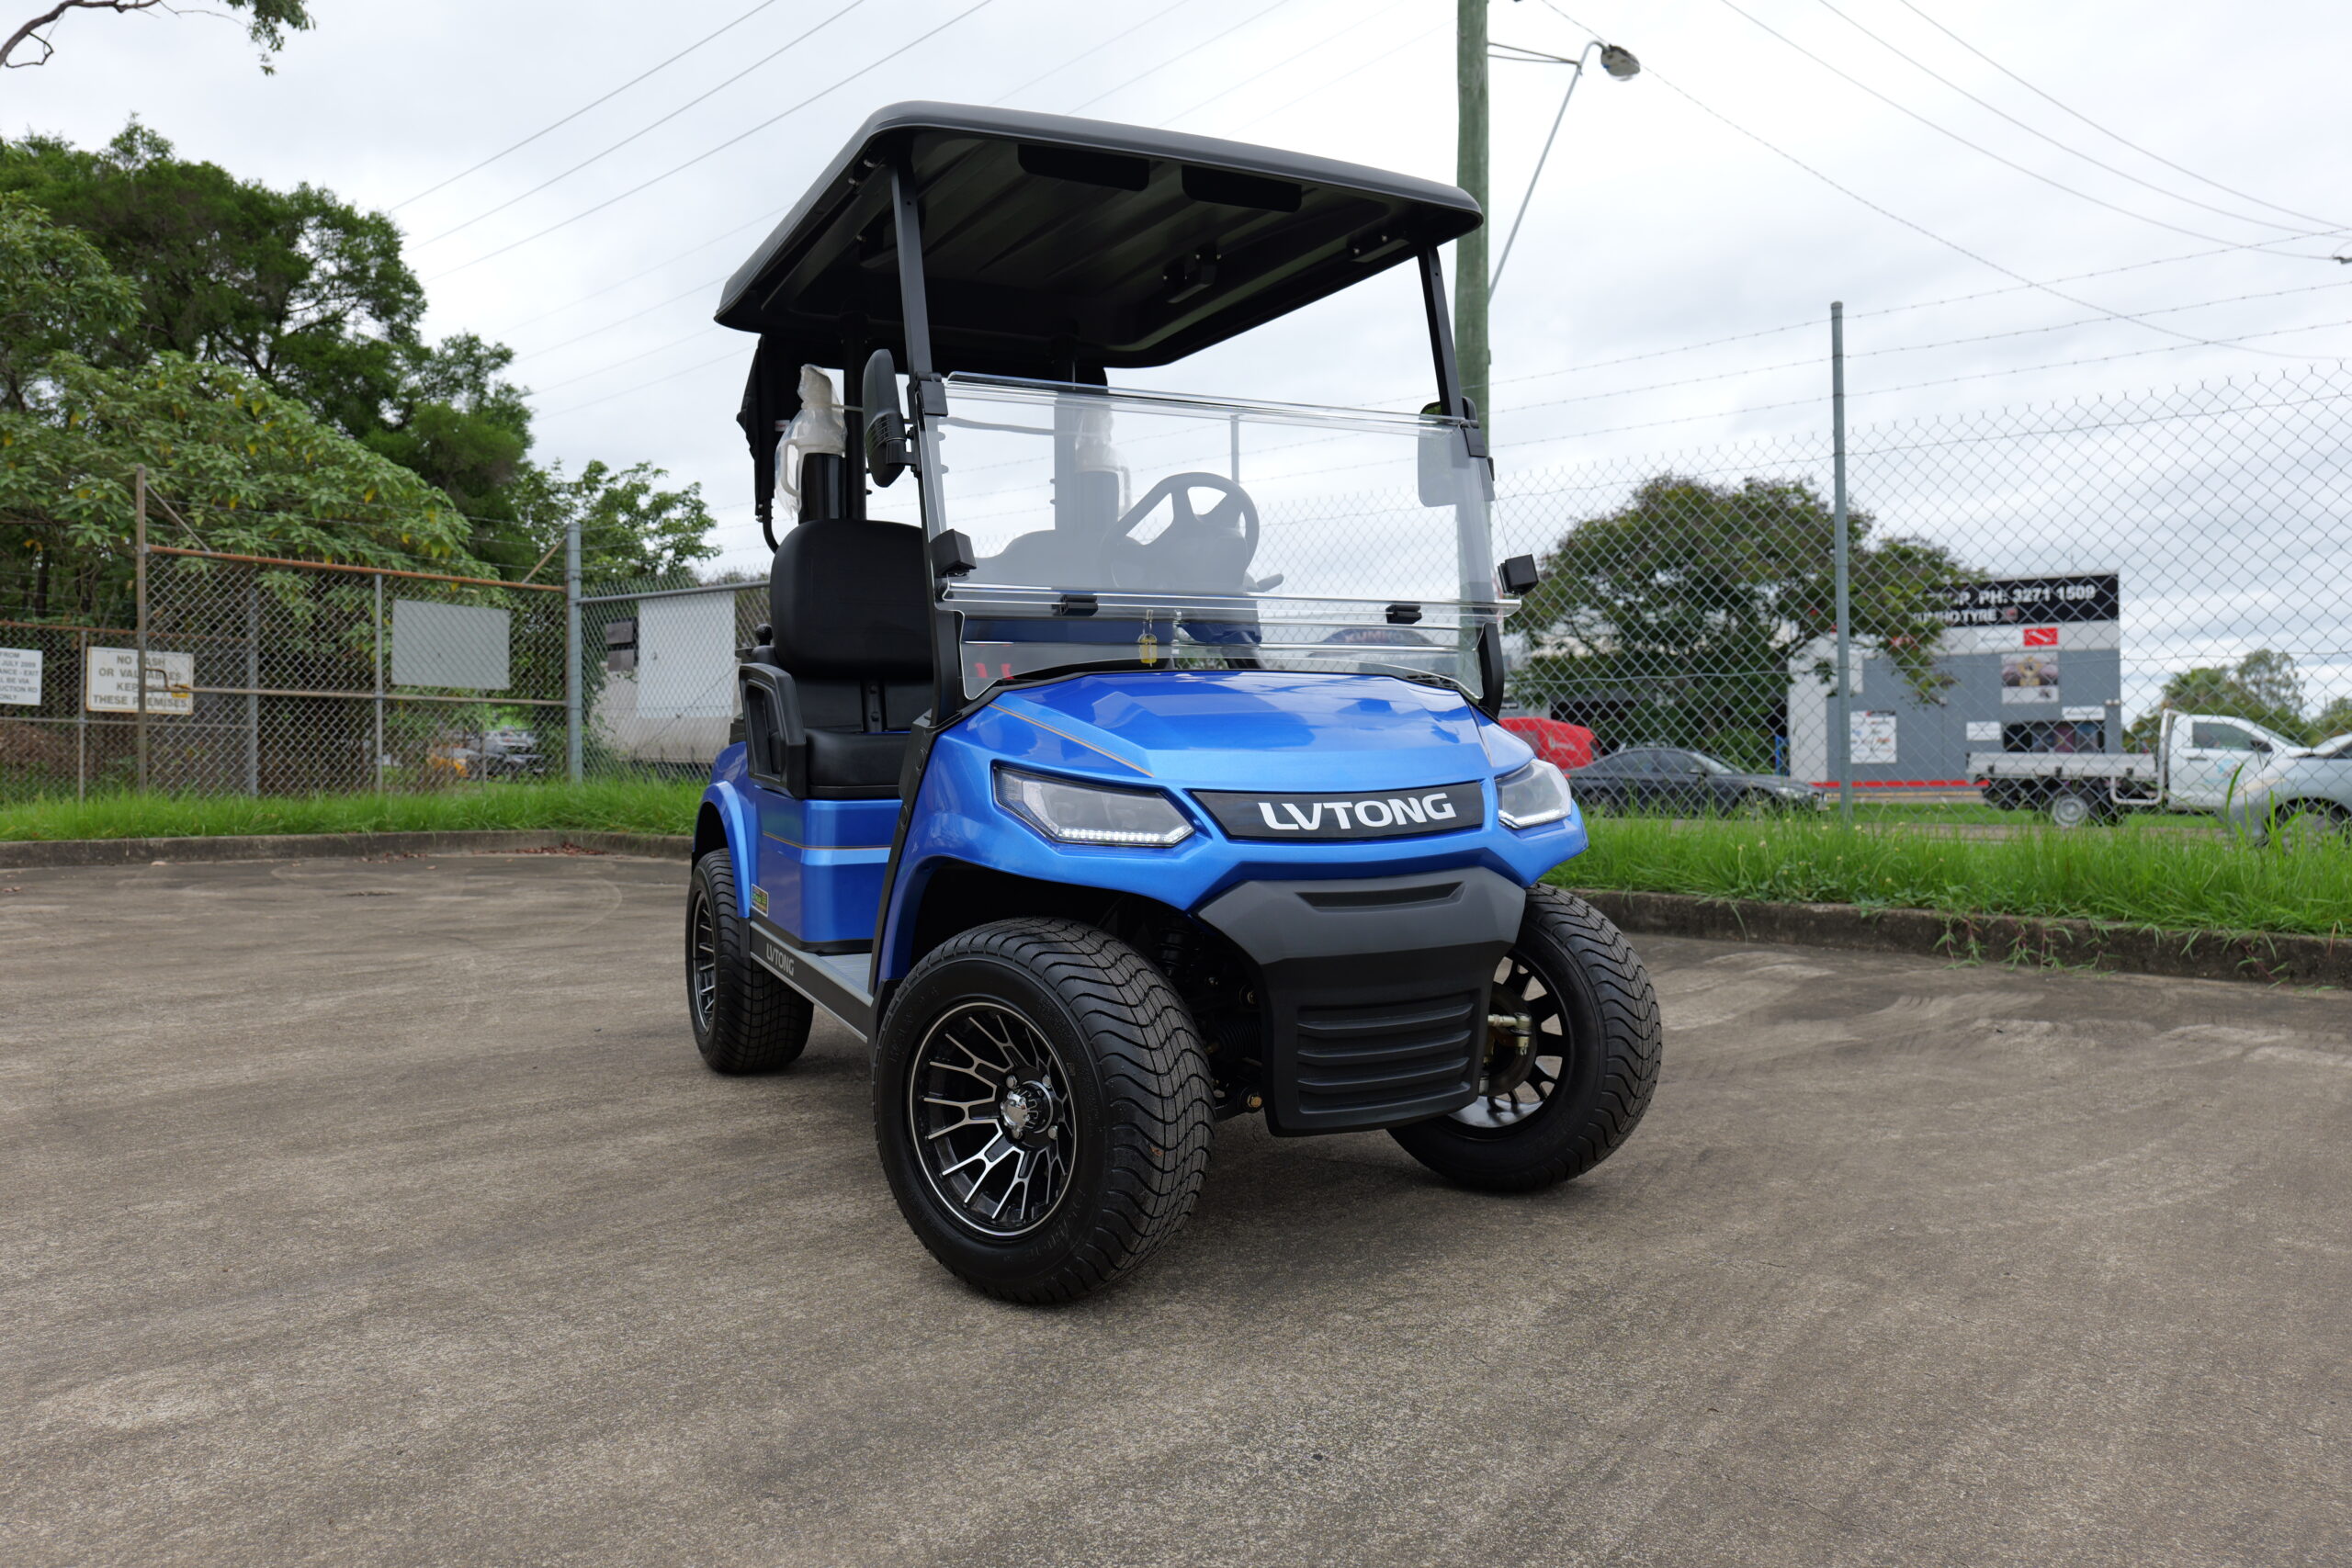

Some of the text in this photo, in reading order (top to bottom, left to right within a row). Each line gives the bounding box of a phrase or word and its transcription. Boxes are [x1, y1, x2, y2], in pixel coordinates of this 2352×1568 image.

[2012, 585, 2051, 603] 3271
[2056, 584, 2097, 601] 1509
[117, 655, 132, 664] NO
[98, 668, 114, 677] OR
[94, 695, 128, 705] THESE
[1257, 793, 1456, 830] LVTONG
[766, 942, 795, 976] LVTONG
